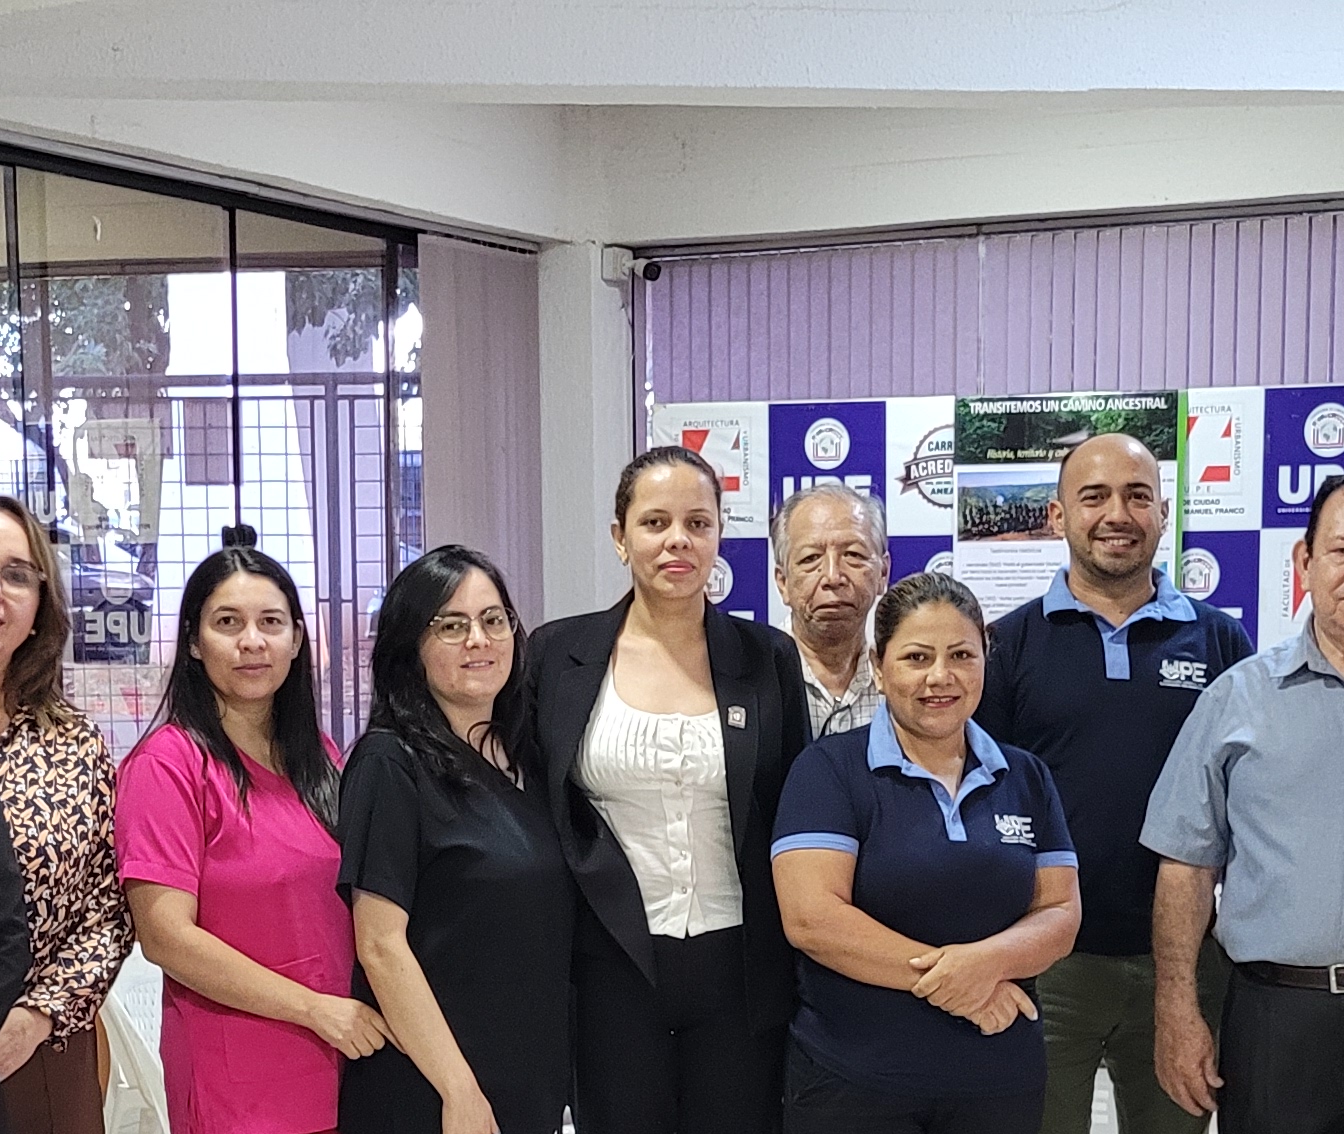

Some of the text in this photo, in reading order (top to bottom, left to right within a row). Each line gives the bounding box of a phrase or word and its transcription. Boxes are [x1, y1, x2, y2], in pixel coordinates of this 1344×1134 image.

[969, 397, 1167, 414] TRANSITEMOS UN CAMINO ANCESTRAL
[1234, 422, 1242, 476] URBANISMO
[1282, 570, 1291, 618] FACULTAD
